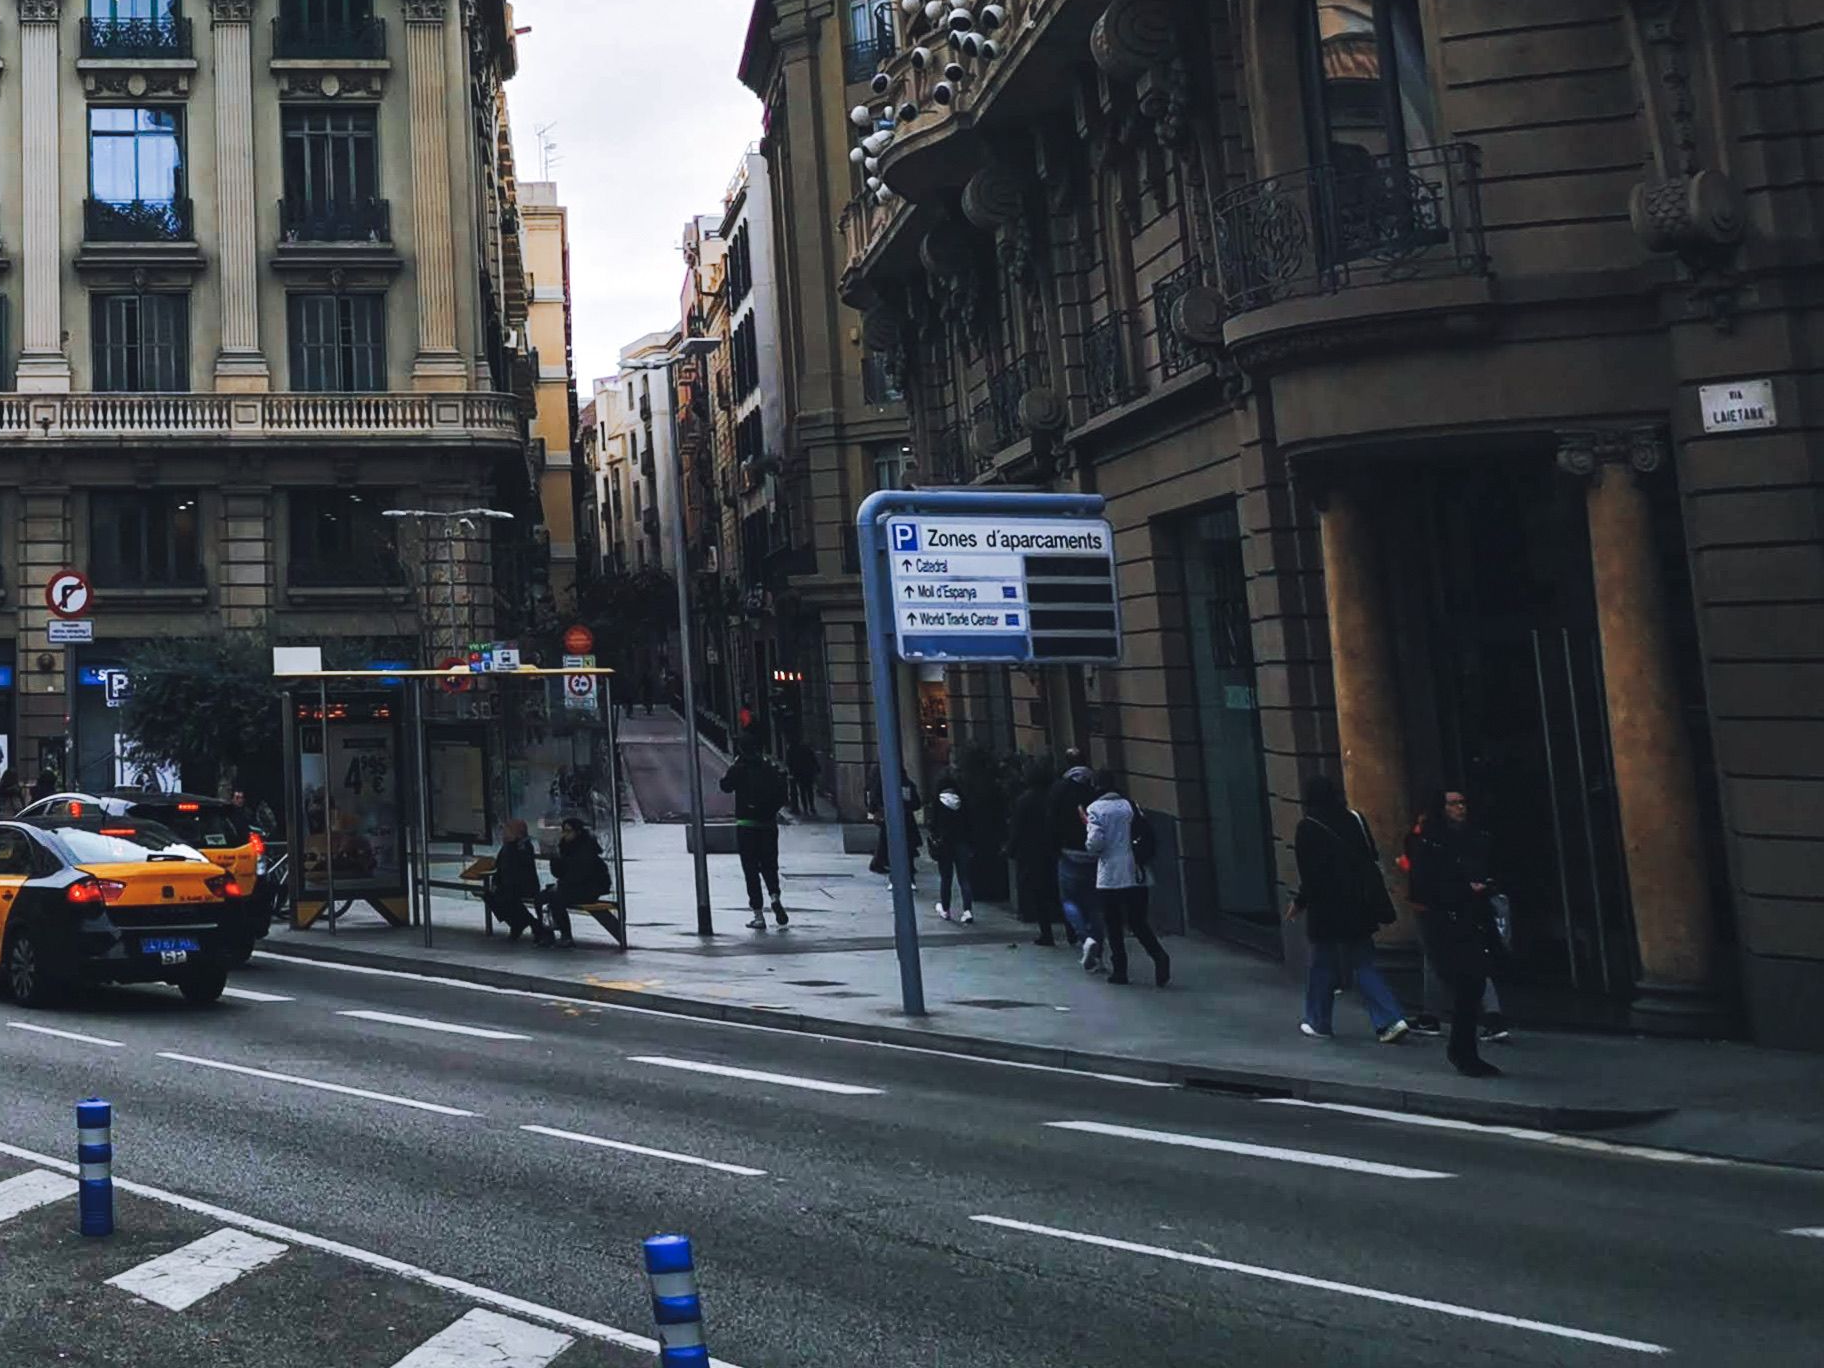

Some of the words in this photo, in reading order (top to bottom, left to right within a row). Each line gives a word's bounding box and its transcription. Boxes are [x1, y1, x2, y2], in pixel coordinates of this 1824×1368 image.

[1728, 390, 1743, 400] VIA
[1713, 407, 1764, 424] LAIETANA
[895, 525, 913, 550] P
[928, 529, 977, 547] Zones
[987, 530, 1103, 551] d'aparcaments
[916, 558, 948, 573] Catedral
[917, 585, 935, 598] Moll
[936, 584, 977, 601] d'Espanya
[919, 612, 945, 625] World
[946, 612, 969, 626] Trade
[970, 612, 999, 626] Center
